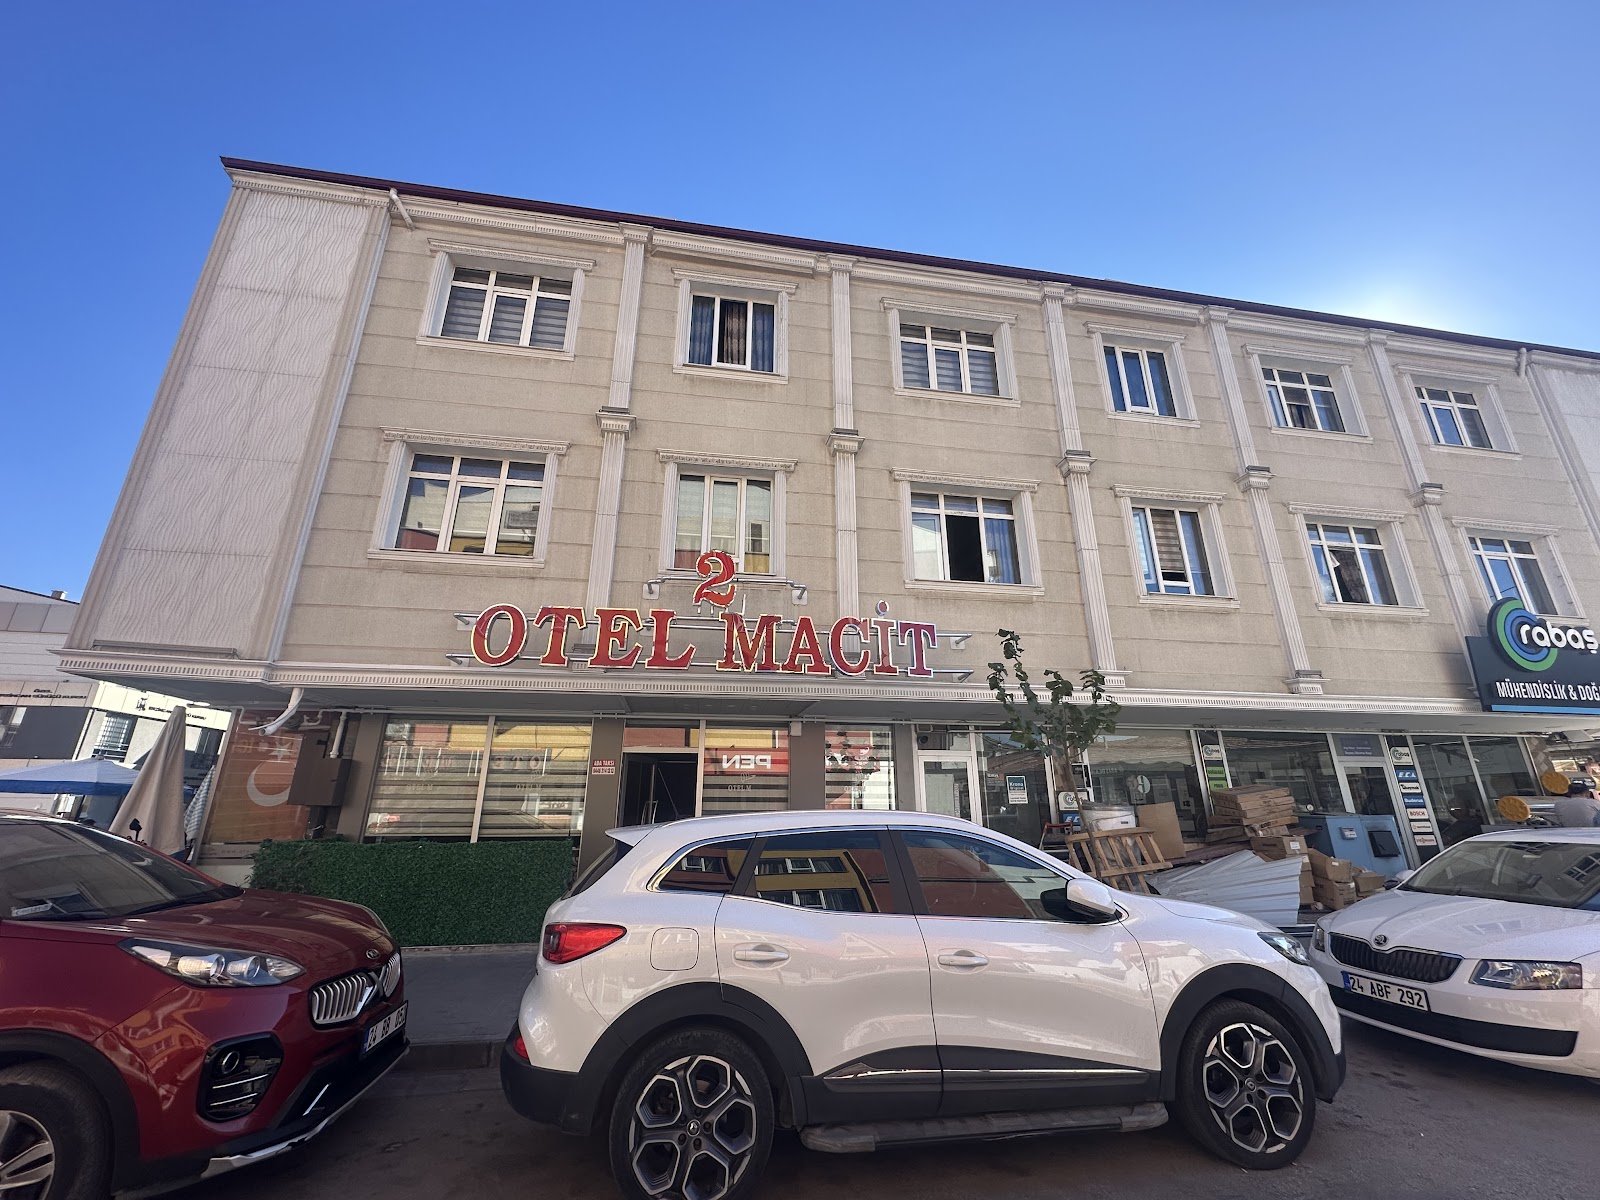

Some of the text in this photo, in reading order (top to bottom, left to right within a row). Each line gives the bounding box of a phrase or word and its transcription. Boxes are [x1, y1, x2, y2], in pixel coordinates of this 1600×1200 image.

[694, 550, 736, 606] 2
[470, 599, 938, 677] OTEL MACİT
[1496, 679, 1567, 700] MÜHENDİSLİK
[1568, 685, 1578, 700] &
[1350, 976, 1425, 1009] 24 ABF 292
